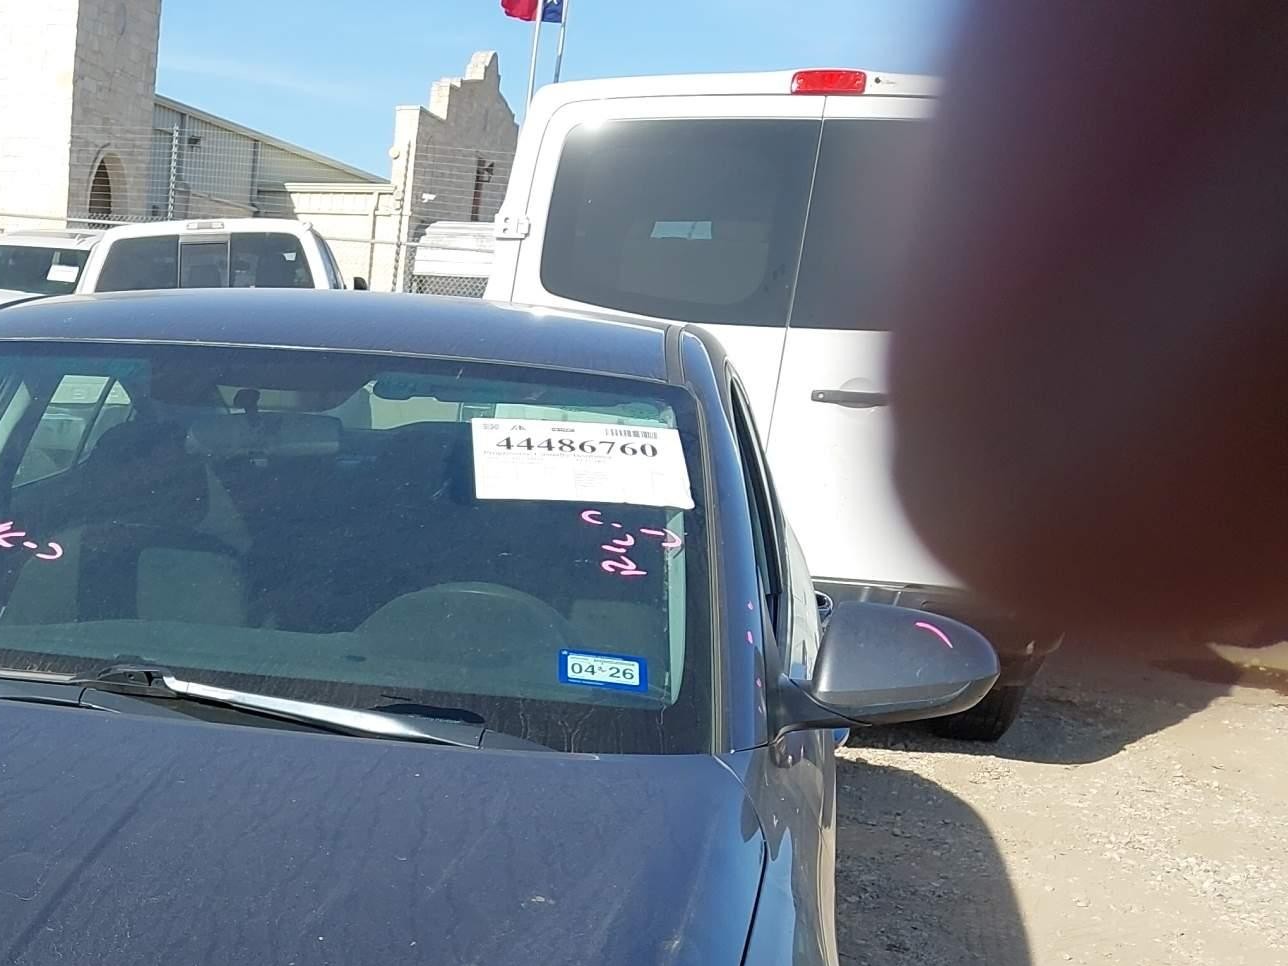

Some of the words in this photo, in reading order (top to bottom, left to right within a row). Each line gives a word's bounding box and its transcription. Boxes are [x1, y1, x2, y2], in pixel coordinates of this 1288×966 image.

[496, 436, 658, 458] 44486760
[570, 662, 596, 676] 04
[608, 666, 635, 680] 26
